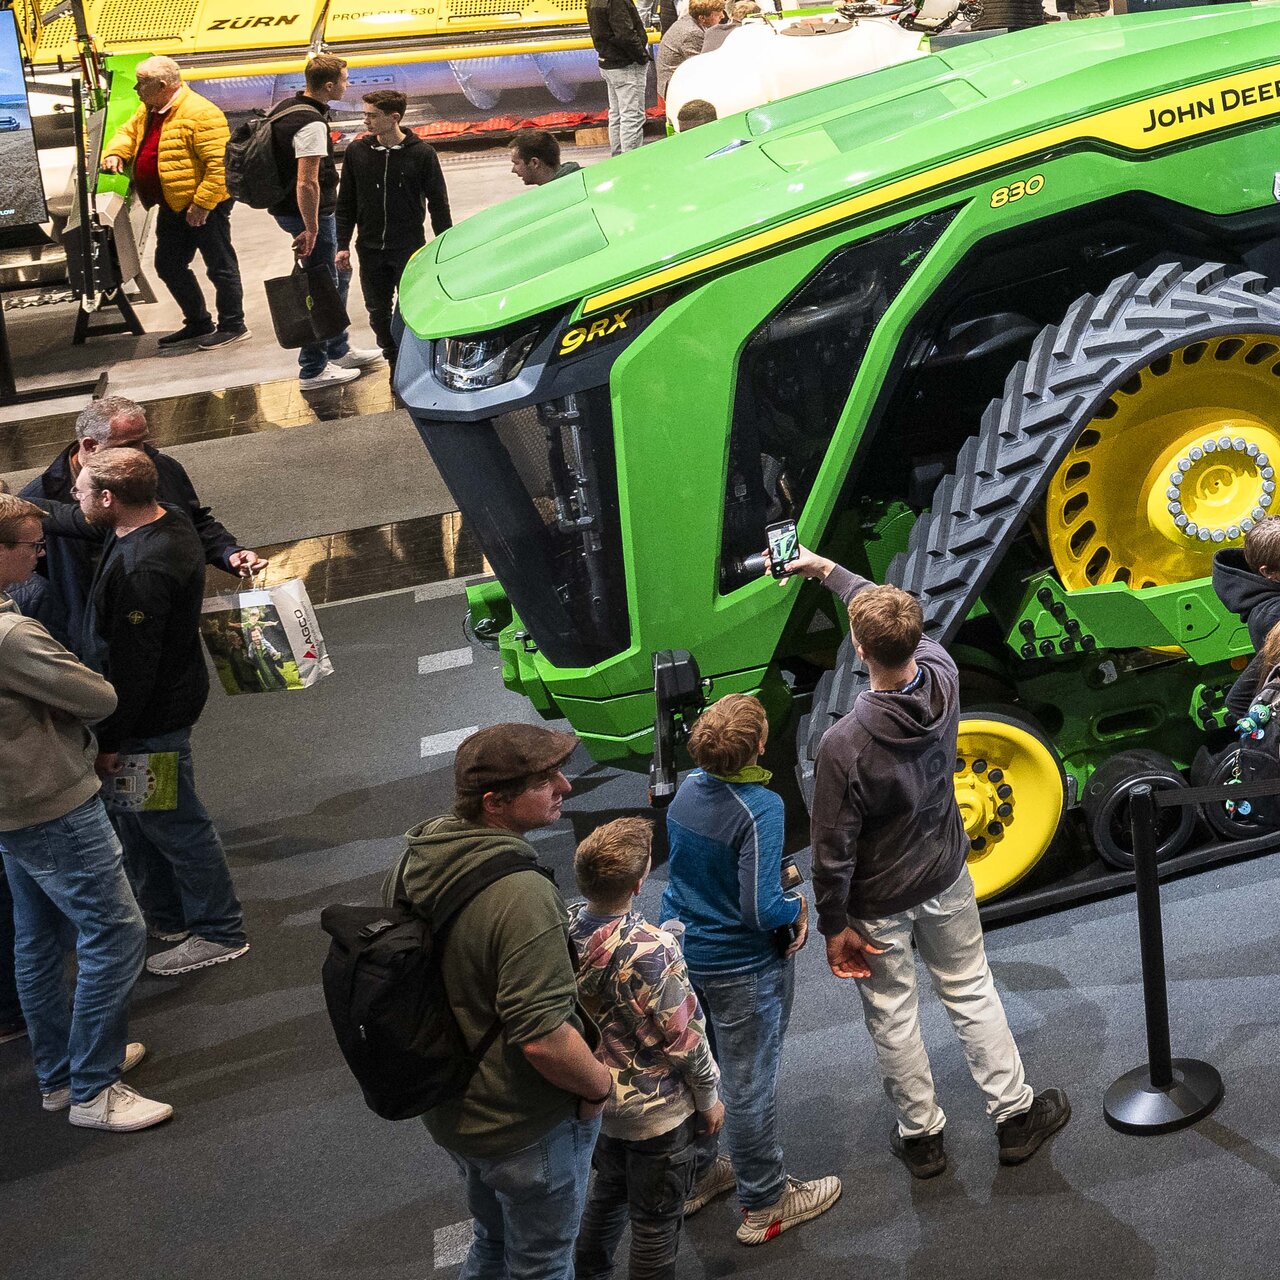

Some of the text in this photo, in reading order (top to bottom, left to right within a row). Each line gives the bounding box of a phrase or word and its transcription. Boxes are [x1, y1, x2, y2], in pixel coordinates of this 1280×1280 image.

[207, 14, 300, 31] ZÜRN
[411, 6, 435, 17] 530
[1143, 97, 1215, 133] JOHN
[989, 173, 1045, 208] 830
[559, 307, 632, 356] 9RX
[294, 609, 313, 645] AGCO
